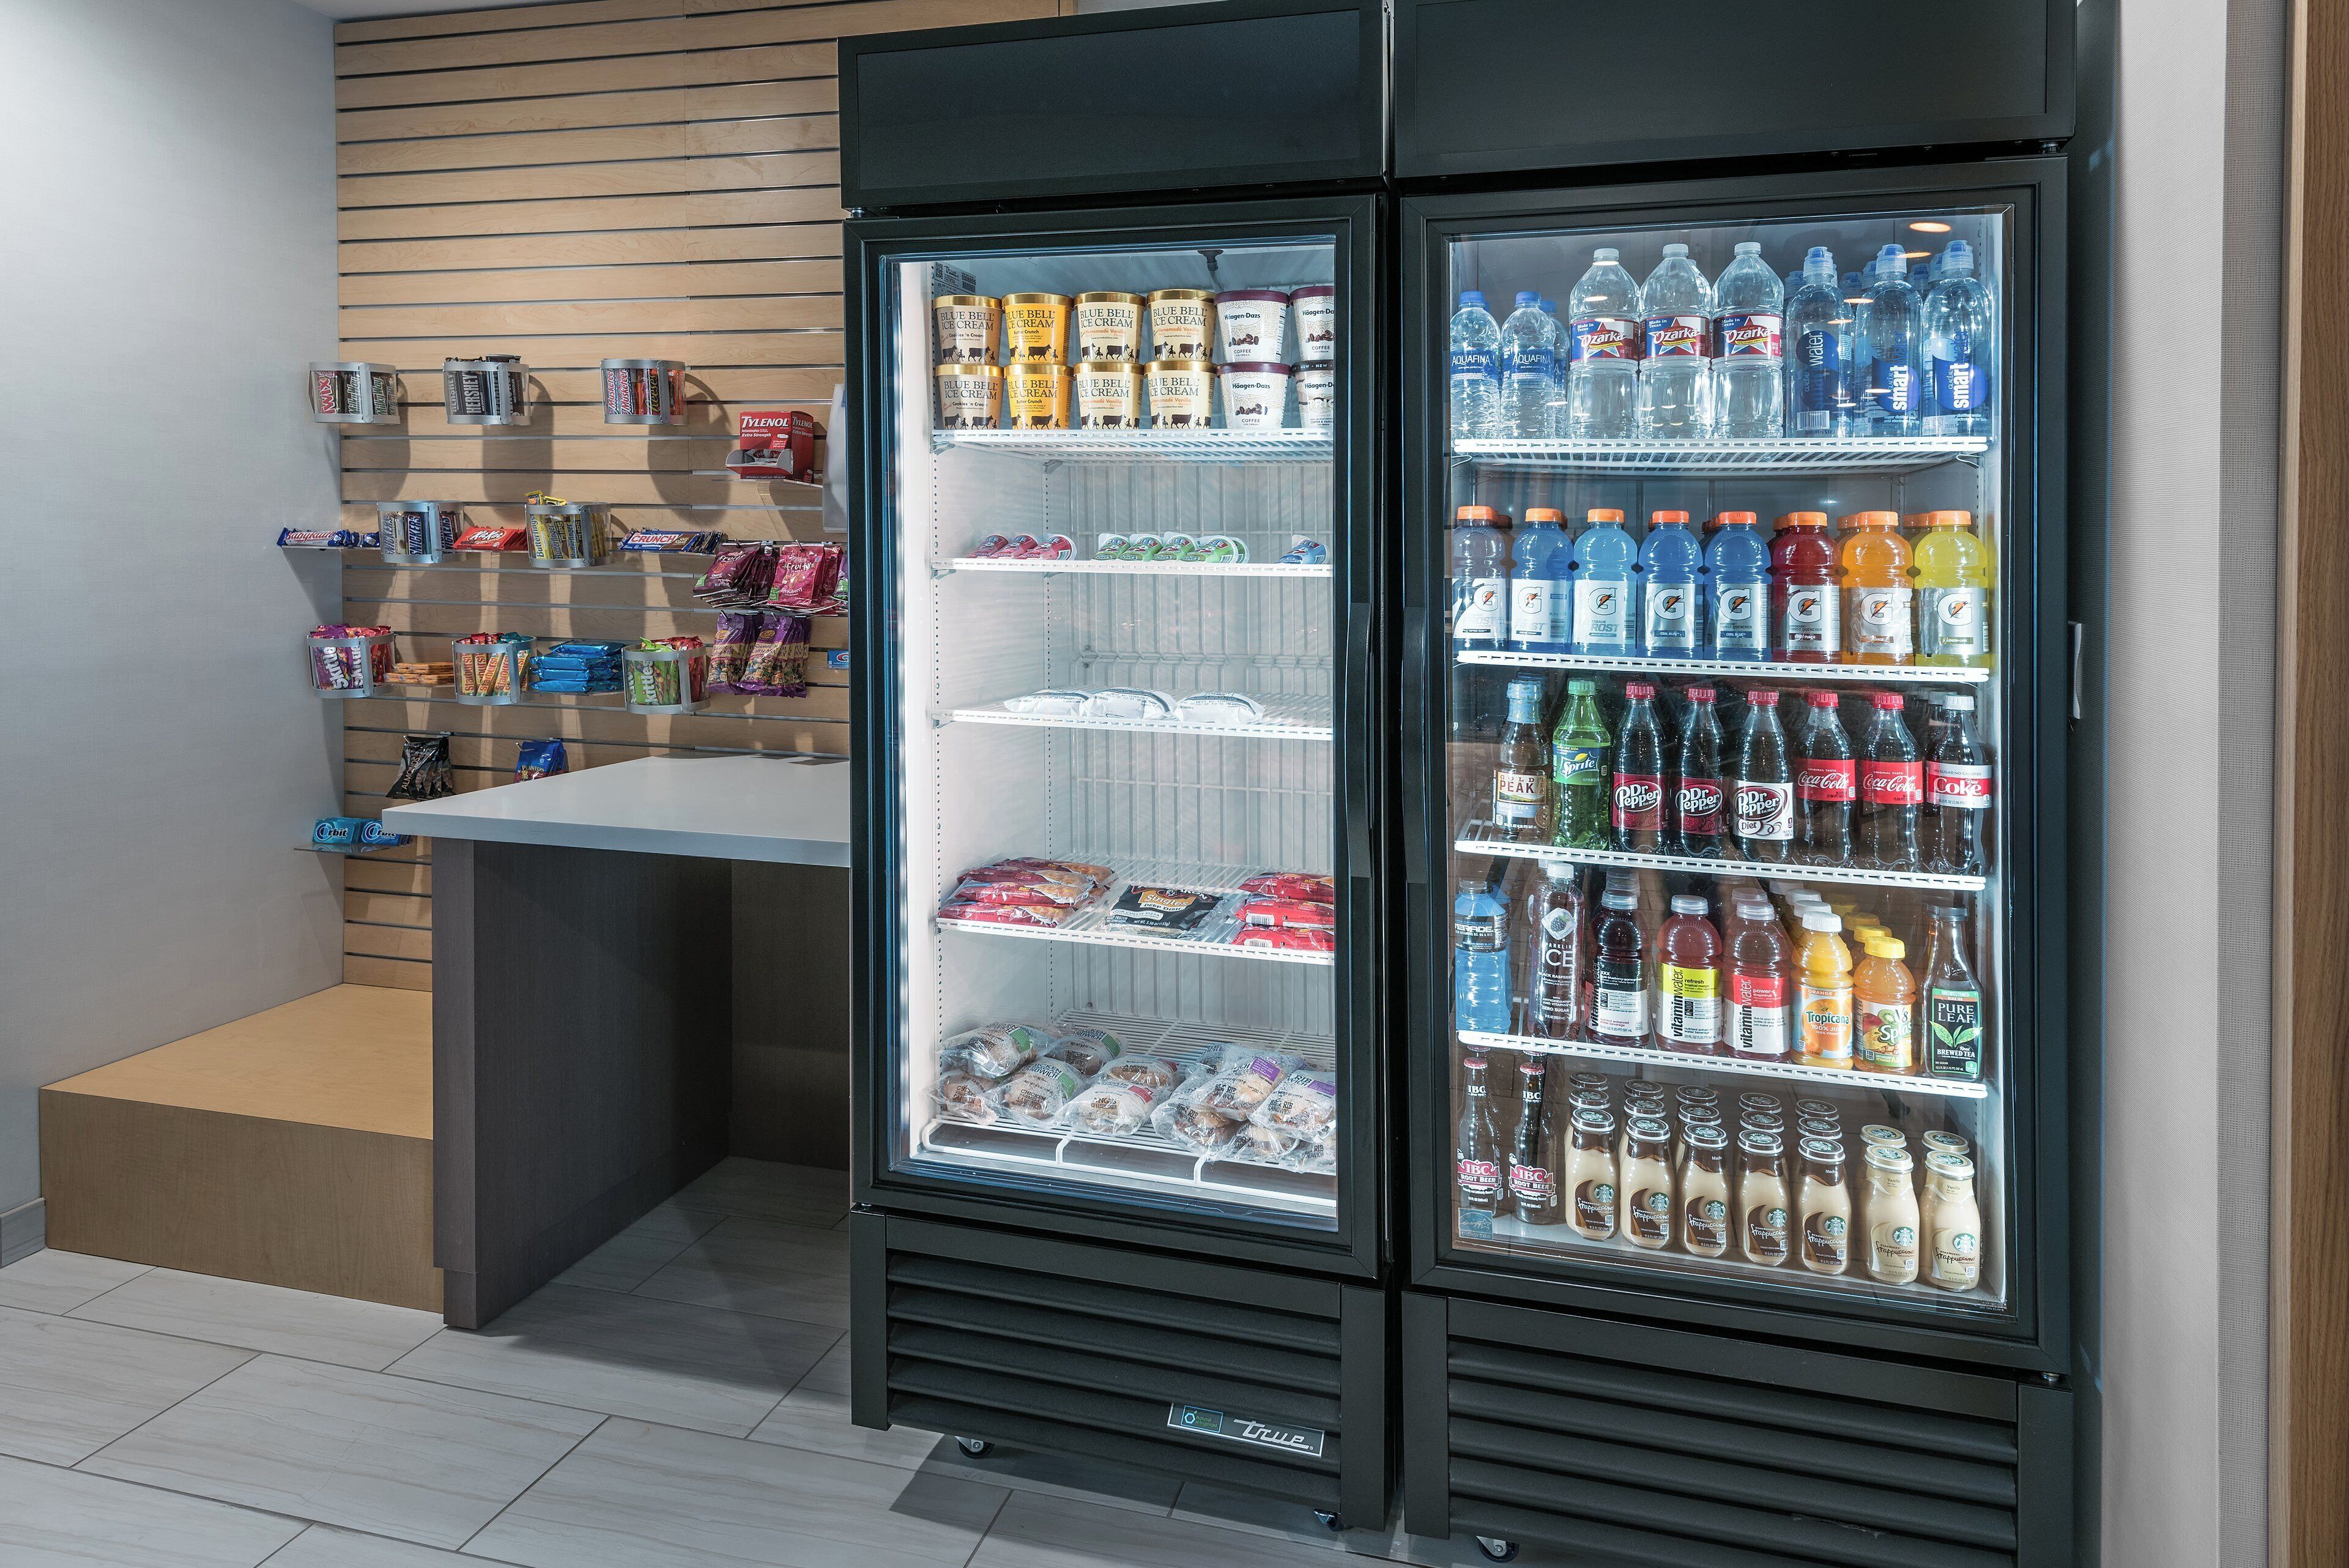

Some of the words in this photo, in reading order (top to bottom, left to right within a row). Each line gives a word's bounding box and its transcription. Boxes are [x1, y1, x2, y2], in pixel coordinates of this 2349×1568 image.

[940, 311, 965, 322] BLUE
[968, 311, 994, 322] BELL
[1006, 310, 1025, 321] BLUE
[1026, 310, 1053, 319] BELL
[1080, 308, 1105, 319] BLUE
[1107, 308, 1133, 319] BELL
[1152, 306, 1178, 318] BLUE
[1179, 306, 1207, 318] BELL
[941, 321, 955, 330] ICE
[956, 321, 994, 331] CREAM
[1080, 319, 1093, 329] ICE
[1094, 318, 1133, 329] CREAM
[1153, 317, 1167, 327] ICE
[1168, 316, 1206, 327] CREAM
[1580, 330, 1624, 349] Ozarka
[1652, 329, 1699, 345] Ozarka
[1725, 327, 1771, 345] Ozarka
[1451, 354, 1491, 367] AQUAFINA
[1512, 354, 1551, 366] AQUAFINA
[944, 381, 970, 390] BLUE
[973, 381, 998, 392] BELL
[1008, 380, 1028, 390] BLUE
[1030, 379, 1056, 389] BELL
[1102, 379, 1129, 388] BELL
[1170, 377, 1199, 387] BELL
[1889, 364, 1909, 411] smart
[1949, 362, 1970, 409] smart
[319, 377, 337, 414] TWIX
[944, 389, 959, 399] ICE
[960, 389, 997, 401] CREAM
[741, 415, 789, 429] TYLENOL
[792, 416, 814, 429] TYLENOL
[408, 515, 422, 555] SNICKERS
[631, 535, 676, 543] CRUNCH
[1473, 584, 1499, 612] G
[1517, 586, 1542, 614] G
[1587, 587, 1617, 616] G
[1653, 587, 1685, 620] G
[1720, 588, 1752, 621] G
[1788, 590, 1822, 623] G
[1860, 592, 1893, 626] G
[1937, 592, 1973, 626] G
[401, 756, 421, 791] ALMONDS
[1562, 759, 1595, 778] Sprite
[1499, 779, 1535, 794] PEAK
[1797, 770, 1850, 790] Coca-Cola
[1862, 773, 1918, 792] Coca-Cola
[1933, 777, 1982, 796] Coke
[1616, 784, 1660, 809] Pepper
[1629, 783, 1649, 797] Dr
[1690, 787, 1710, 800] Dr
[1749, 790, 1767, 802] Dr
[1680, 789, 1721, 813] Pepper
[1737, 793, 1779, 817] Pepper
[1741, 820, 1757, 830] Diet
[1144, 894, 1189, 907] Singles
[1540, 949, 1574, 968] ICE
[1589, 960, 1600, 1027] vitaminwater
[1671, 968, 1683, 1037] vitaminwater
[1937, 1002, 1975, 1015] PURE
[1740, 978, 1753, 1049] vitaminwater
[1805, 1011, 1850, 1025] Tropicana
[1937, 1048, 1964, 1057] BREWED
[1963, 1050, 1976, 1058] TEA
[1293, 1074, 1312, 1084] RIB
[1020, 1088, 1047, 1101] CHICKEN
[1468, 1085, 1486, 1094] IBC
[1522, 1091, 1542, 1100] IBC
[1465, 1162, 1491, 1176] IBC
[1518, 1169, 1544, 1182] IBC
[1460, 1173, 1479, 1182] ROOT
[1513, 1178, 1532, 1187] ROOT
[1532, 1181, 1549, 1190] BEER
[1576, 1197, 1614, 1214] frappuccino
[1632, 1205, 1670, 1222] frappuccino
[1688, 1213, 1726, 1230] frappuccino
[1750, 1223, 1788, 1241] frappuccino
[1806, 1230, 1847, 1247] frappuccino
[1876, 1240, 1915, 1260] frappuccino
[1935, 1246, 1975, 1265] frappuccino
[1233, 1418, 1310, 1450] true
